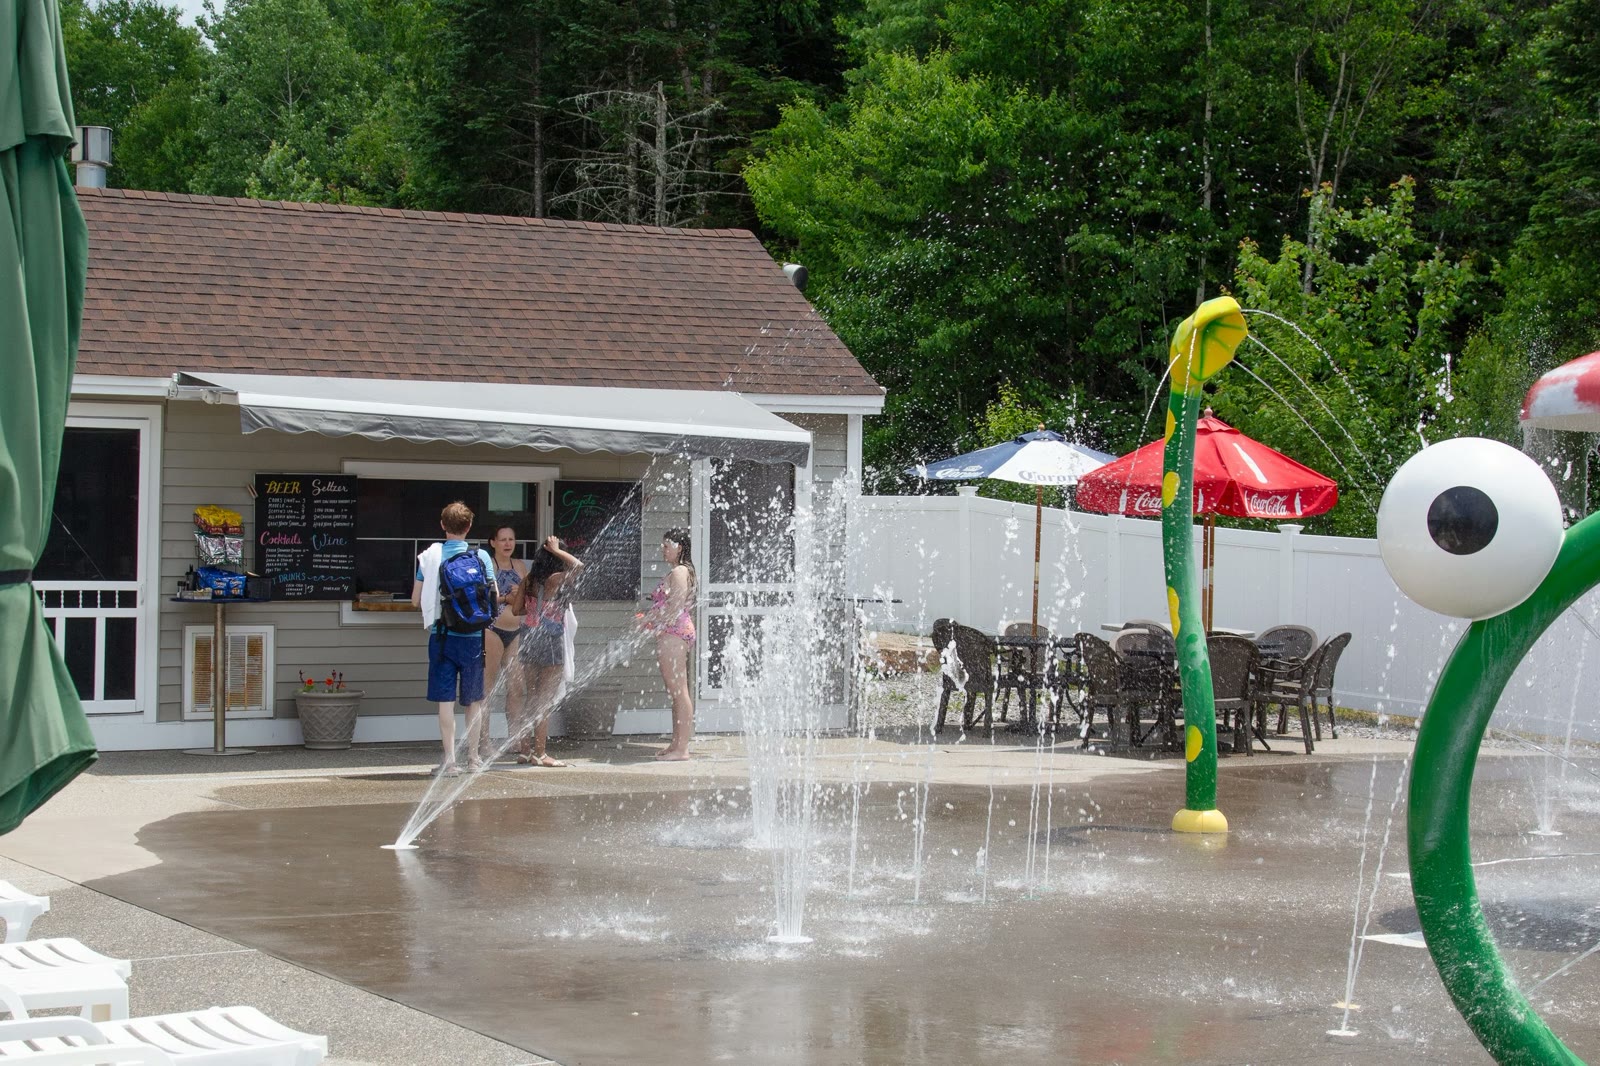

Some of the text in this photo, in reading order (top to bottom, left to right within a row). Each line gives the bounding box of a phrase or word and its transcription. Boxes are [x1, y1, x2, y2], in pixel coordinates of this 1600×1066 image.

[1018, 470, 1078, 483] Coron
[265, 480, 301, 494] BEER
[311, 479, 348, 496] Seltzer
[260, 531, 302, 545] Cocktails
[312, 533, 347, 550] Wine
[278, 572, 306, 583] DRINKS
